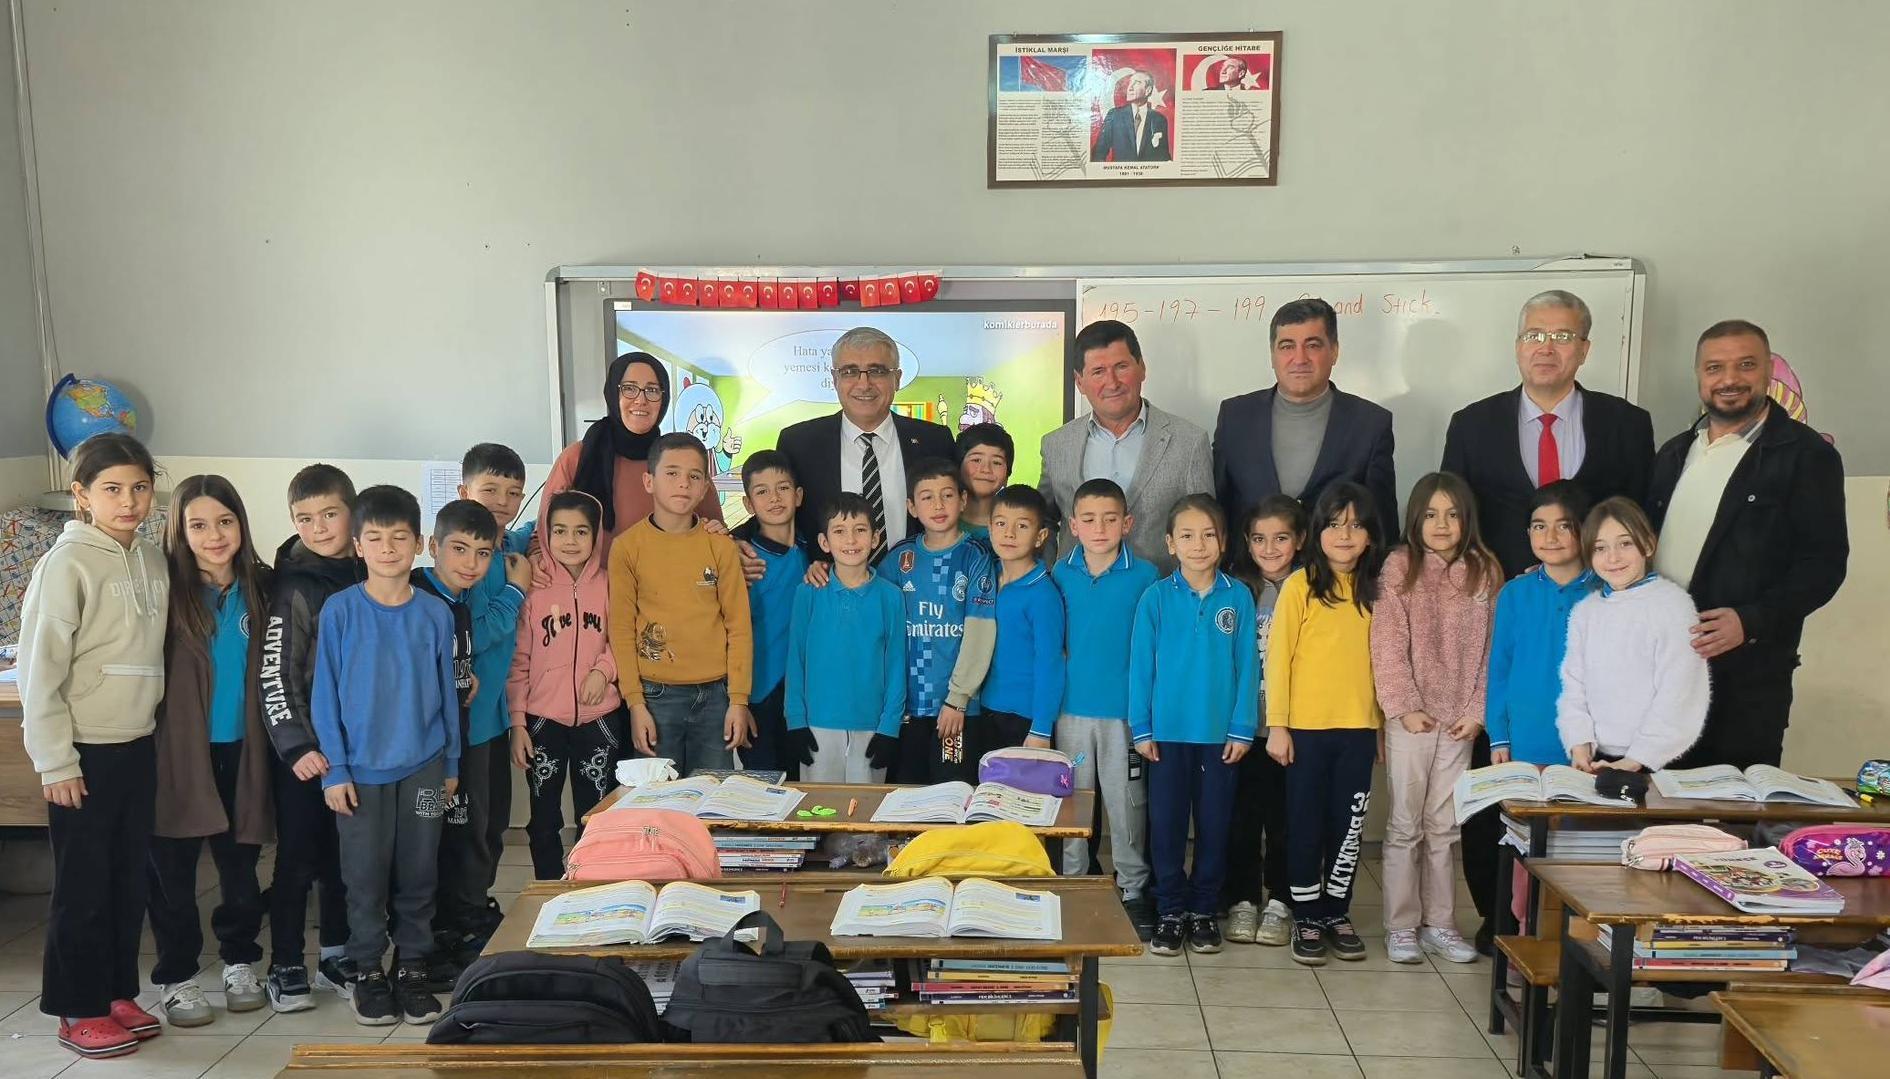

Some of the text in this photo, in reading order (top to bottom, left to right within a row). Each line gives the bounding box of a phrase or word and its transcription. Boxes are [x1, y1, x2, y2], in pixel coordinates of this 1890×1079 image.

[1233, 294, 1266, 322] 199
[793, 345, 818, 357] Hata
[783, 363, 820, 375] yemesi
[918, 601, 944, 620] Fly
[260, 615, 293, 727] ADVENTURE
